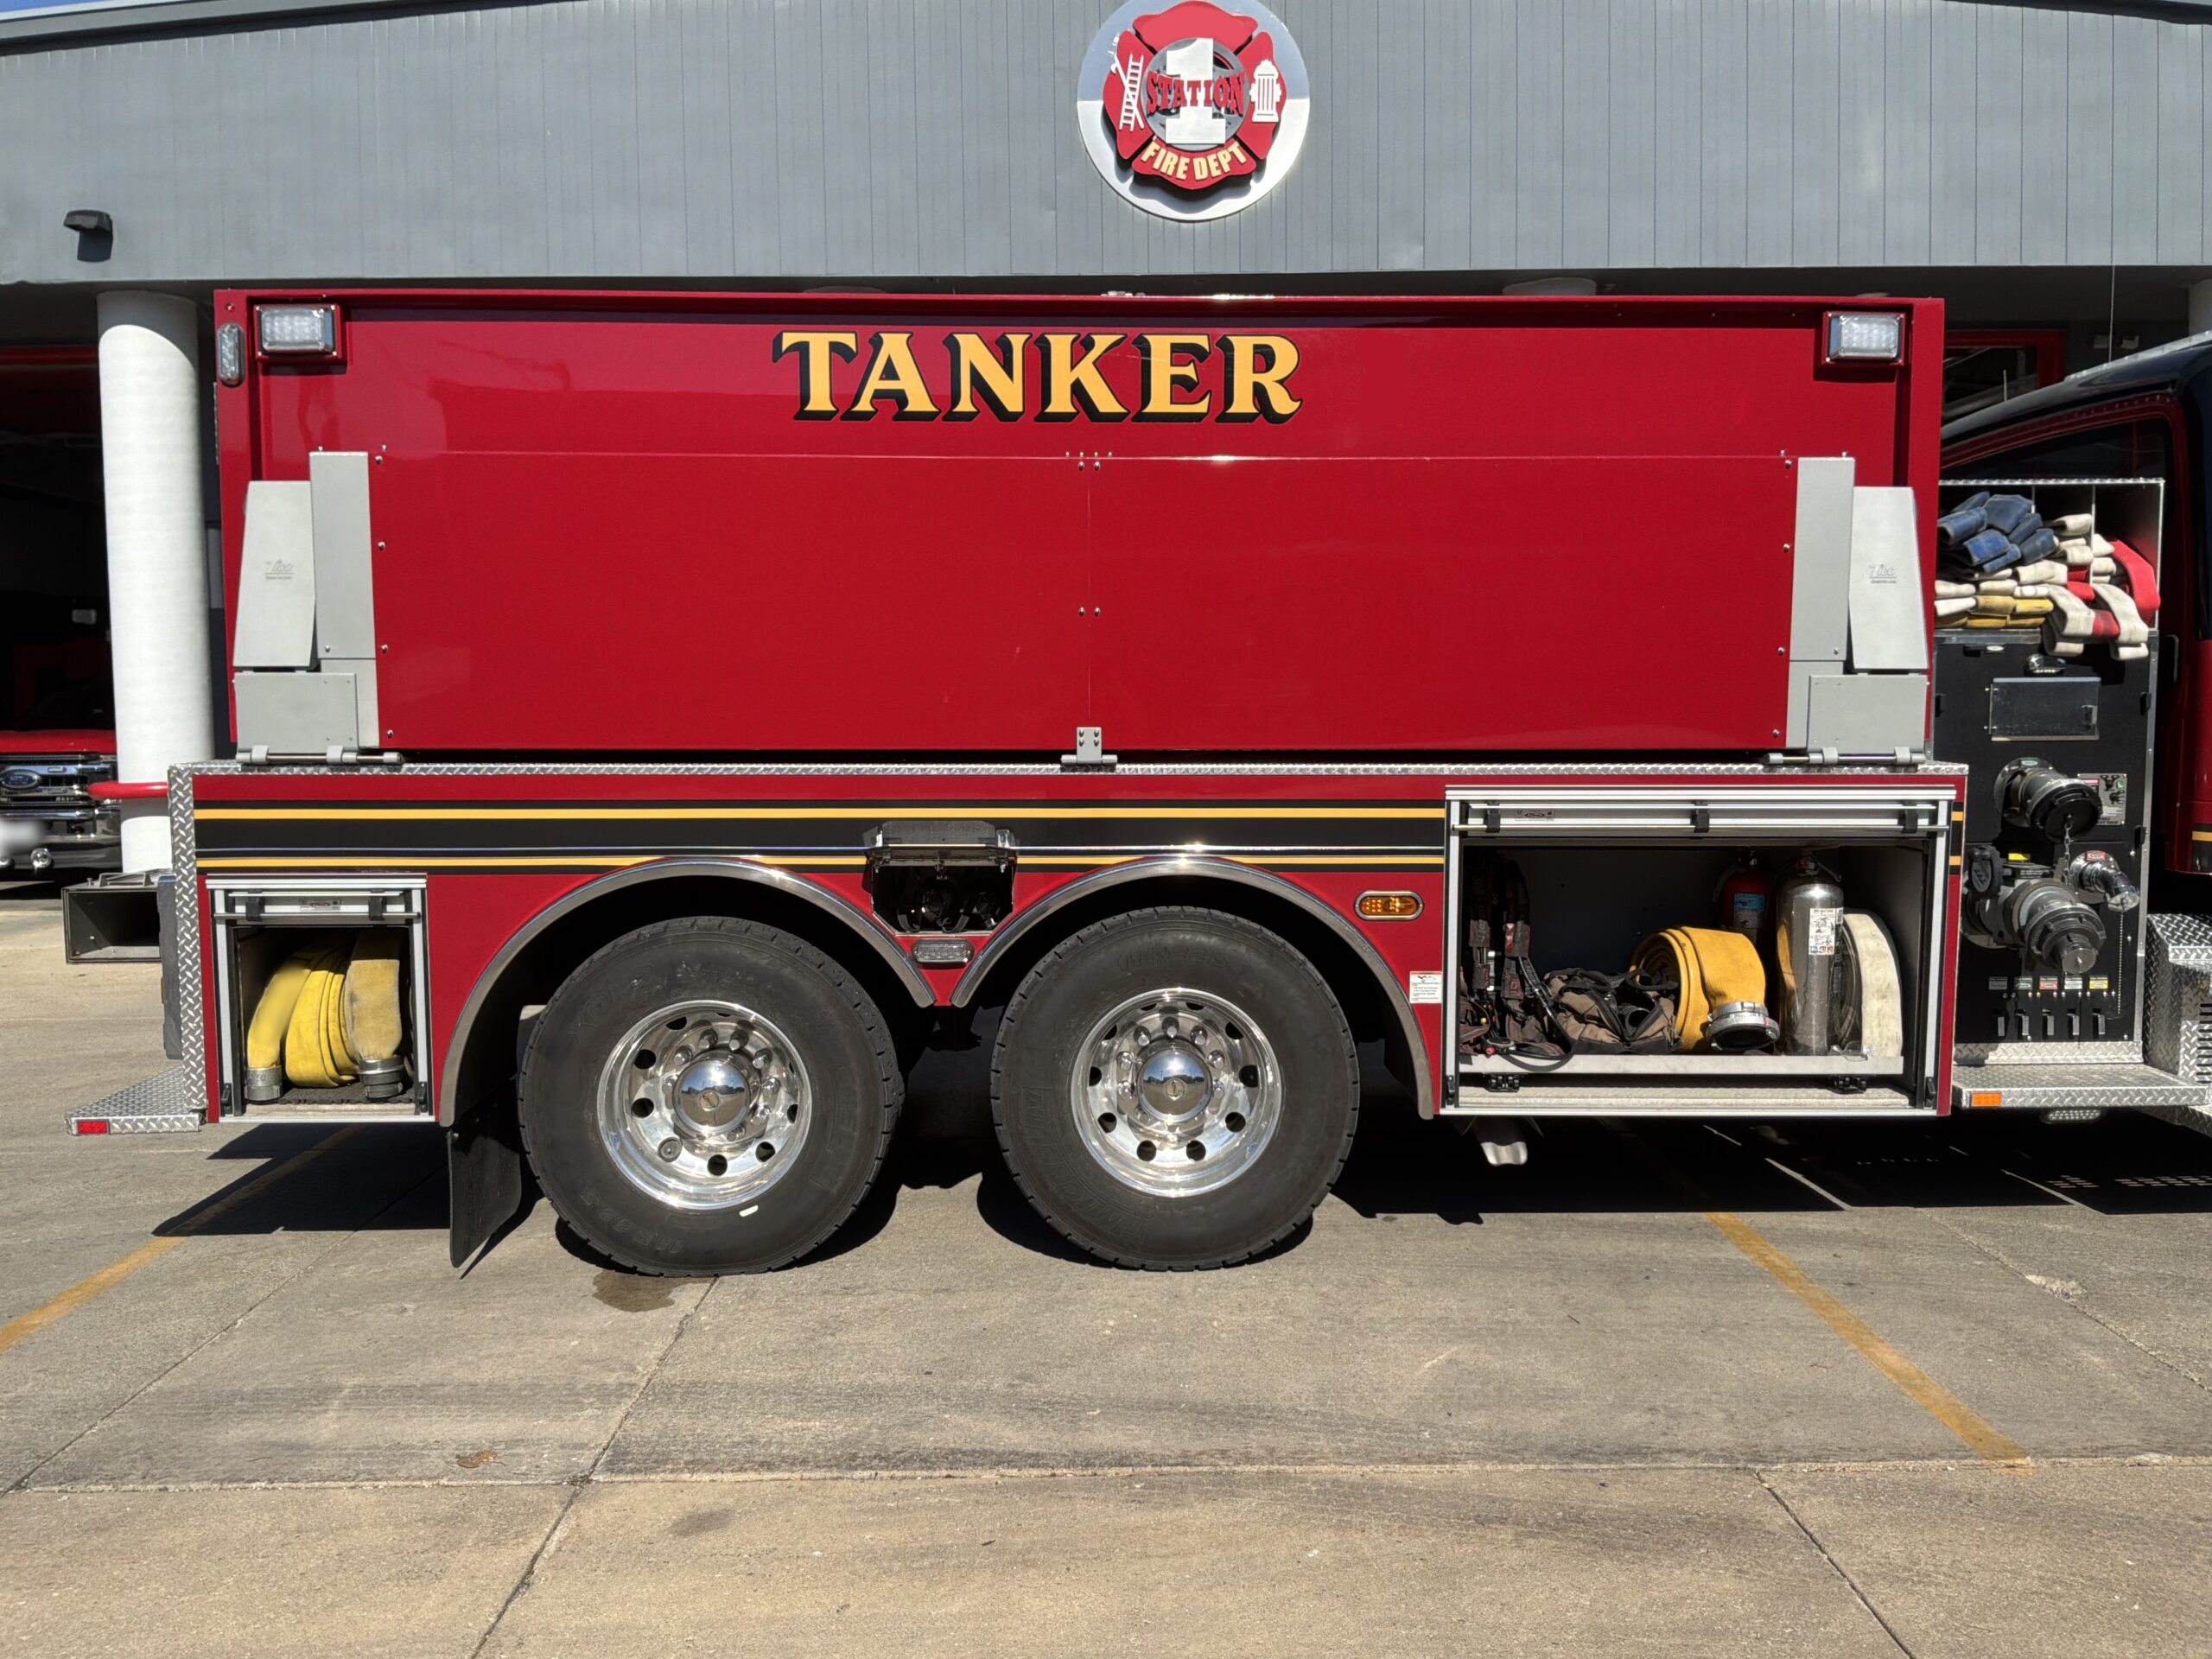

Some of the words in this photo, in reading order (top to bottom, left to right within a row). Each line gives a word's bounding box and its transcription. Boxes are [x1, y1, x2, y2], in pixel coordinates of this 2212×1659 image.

[1147, 71, 1244, 115] STATION
[1166, 38, 1225, 143] 1
[1141, 141, 1190, 180] FIRE
[1193, 142, 1247, 180] DEPT
[772, 332, 1302, 424] TANKER
